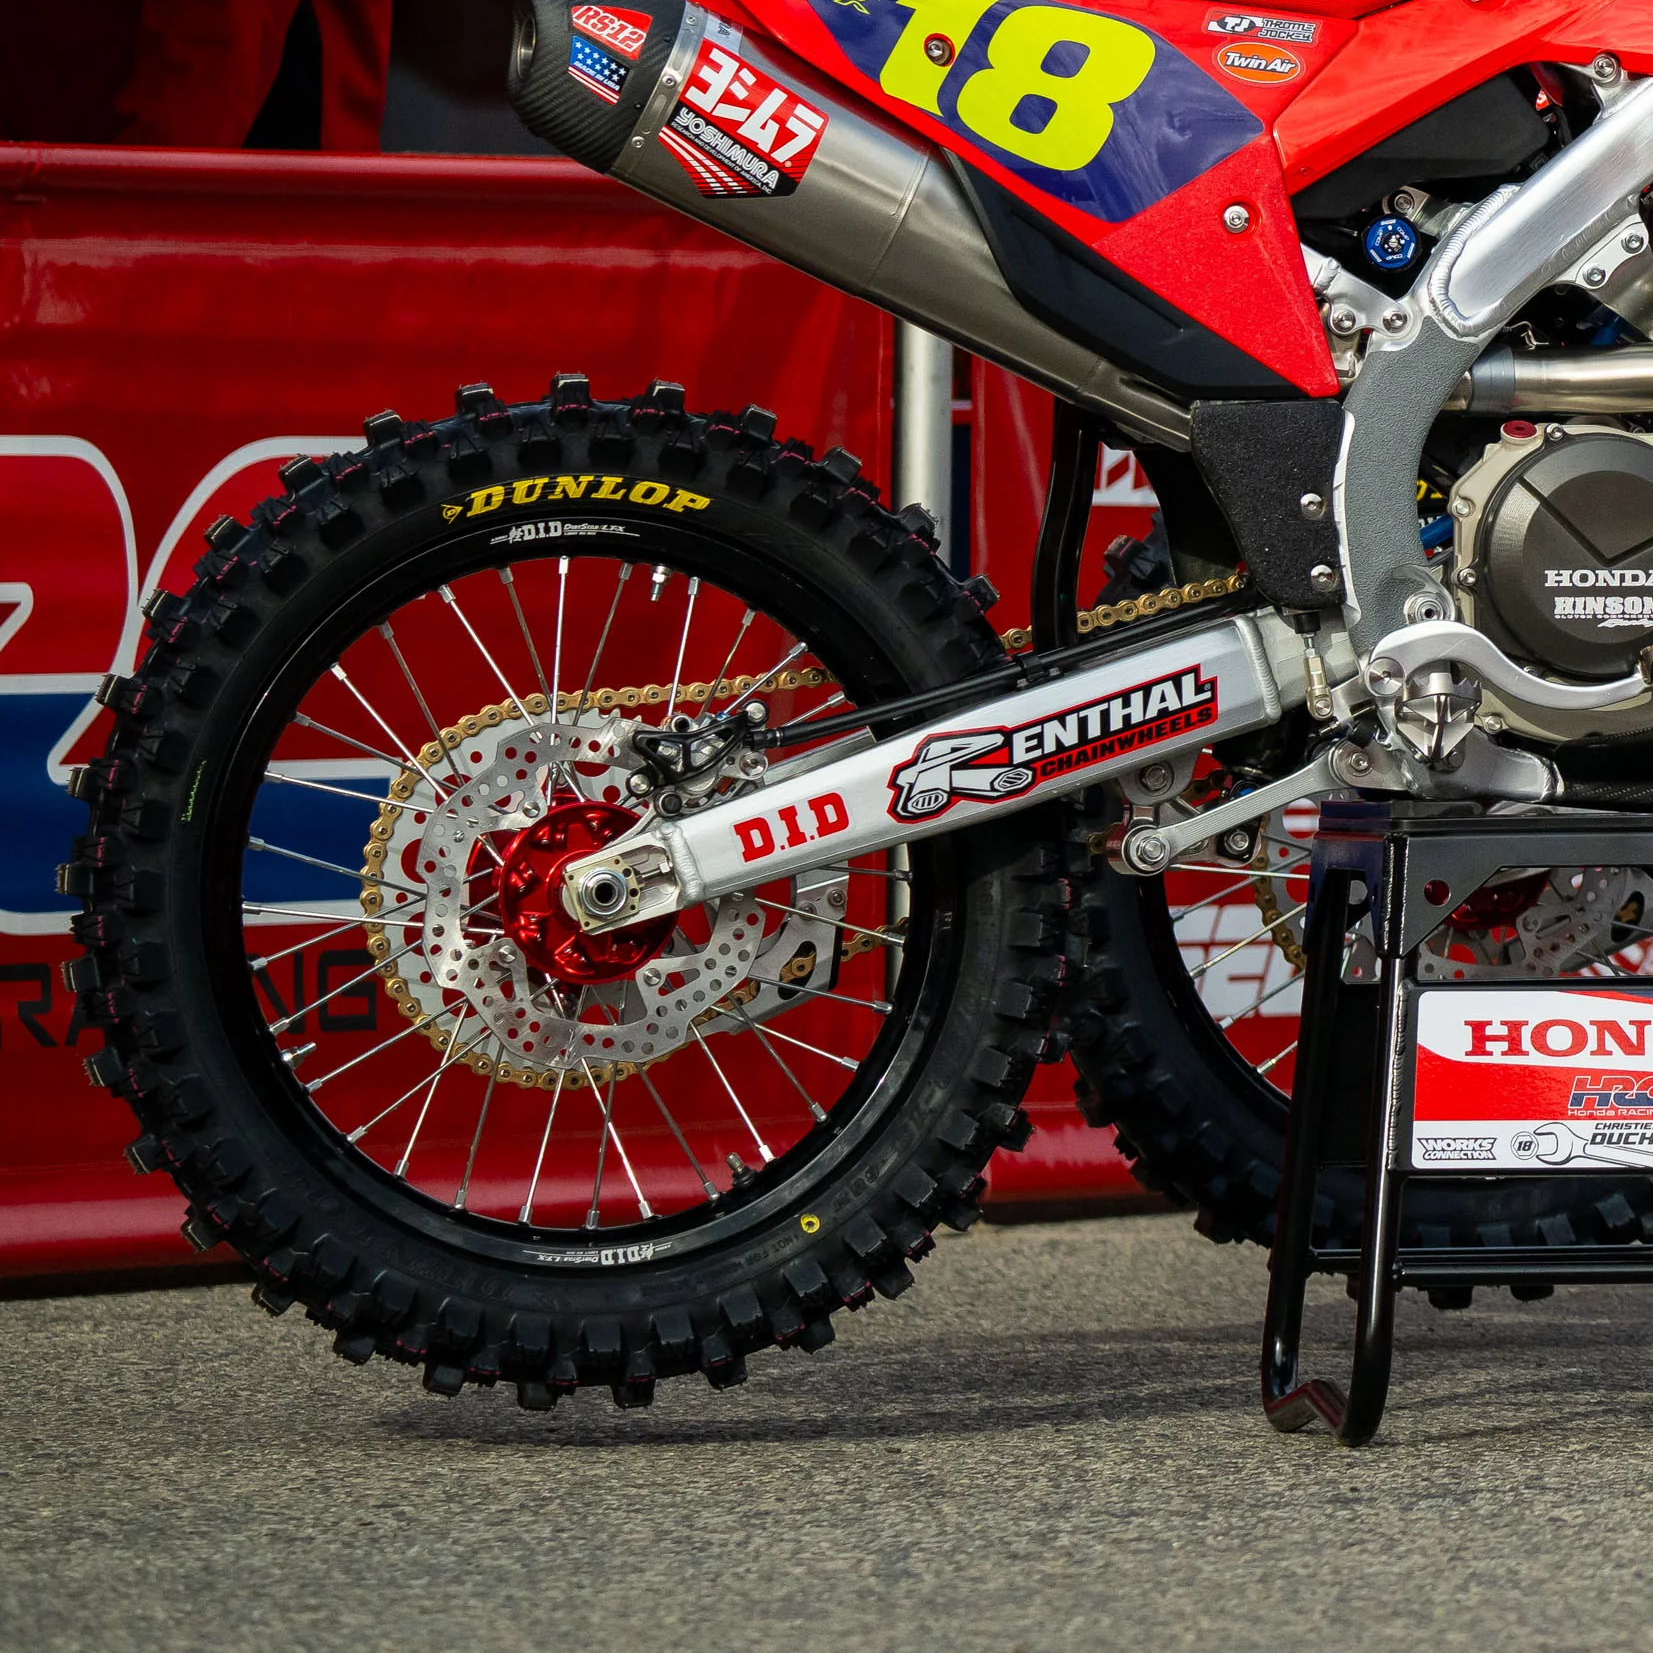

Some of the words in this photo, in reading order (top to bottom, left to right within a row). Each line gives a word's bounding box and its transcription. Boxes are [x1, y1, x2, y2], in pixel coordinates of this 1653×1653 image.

[1226, 52, 1267, 70] Twin
[1266, 57, 1296, 73] Air
[674, 107, 780, 189] YOSHIMURA
[466, 475, 711, 517] DUNLOP
[1040, 705, 1214, 779] CHAINWHEELS
[733, 792, 851, 862] D.I.D
[1567, 1108, 1616, 1116] Honda
[1418, 1137, 1497, 1151] WORKS
[1423, 1149, 1497, 1160] CONNECTION
[1516, 1139, 1534, 1152] 18
